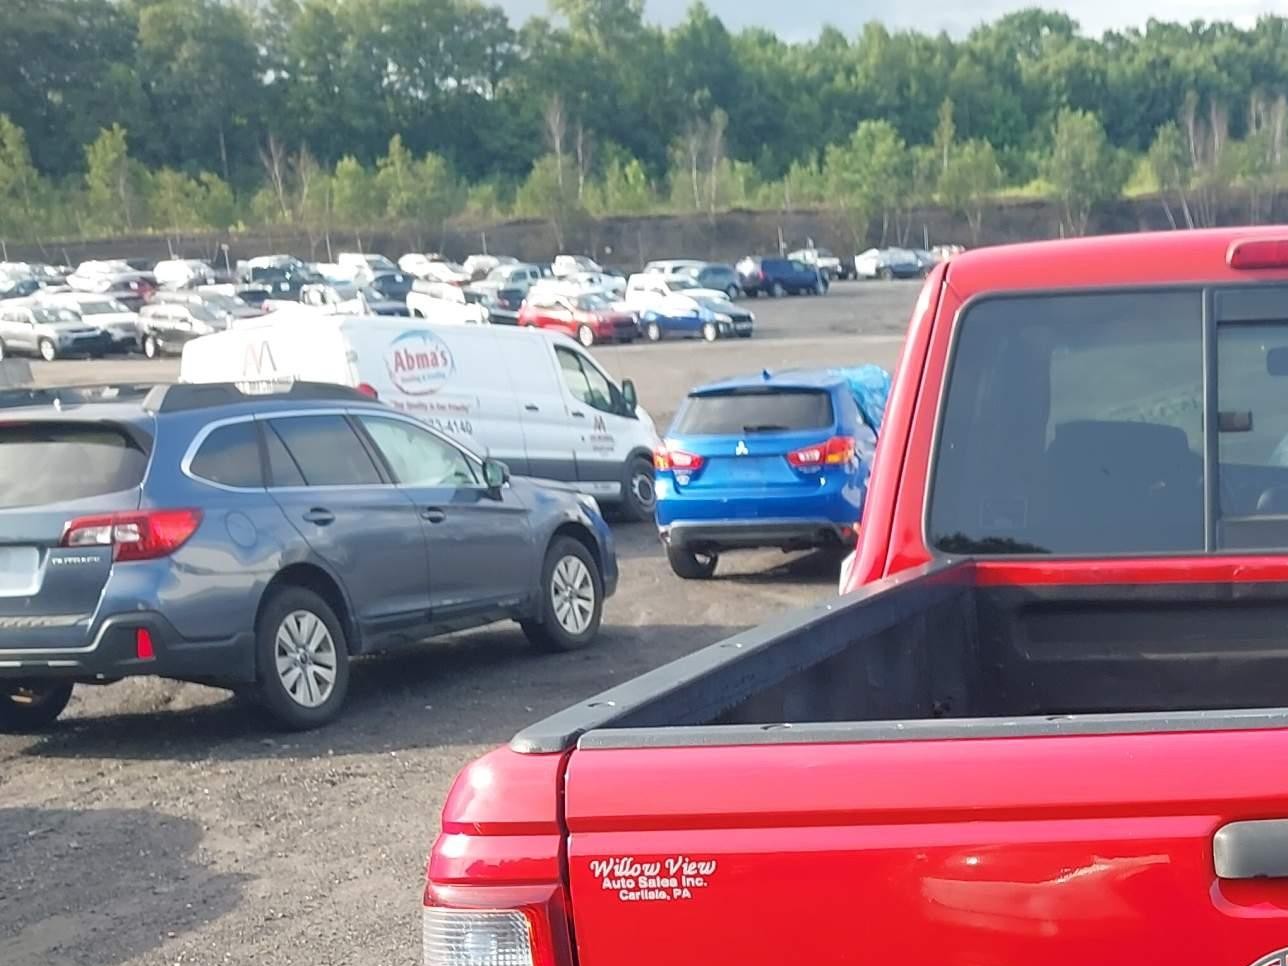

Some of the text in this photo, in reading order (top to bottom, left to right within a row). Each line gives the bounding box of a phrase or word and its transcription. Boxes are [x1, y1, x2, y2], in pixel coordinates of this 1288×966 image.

[394, 345, 448, 373] Abma's
[590, 856, 717, 878] Willow View
[602, 875, 708, 889] Auto Sales Inc.
[673, 888, 692, 899] PA
